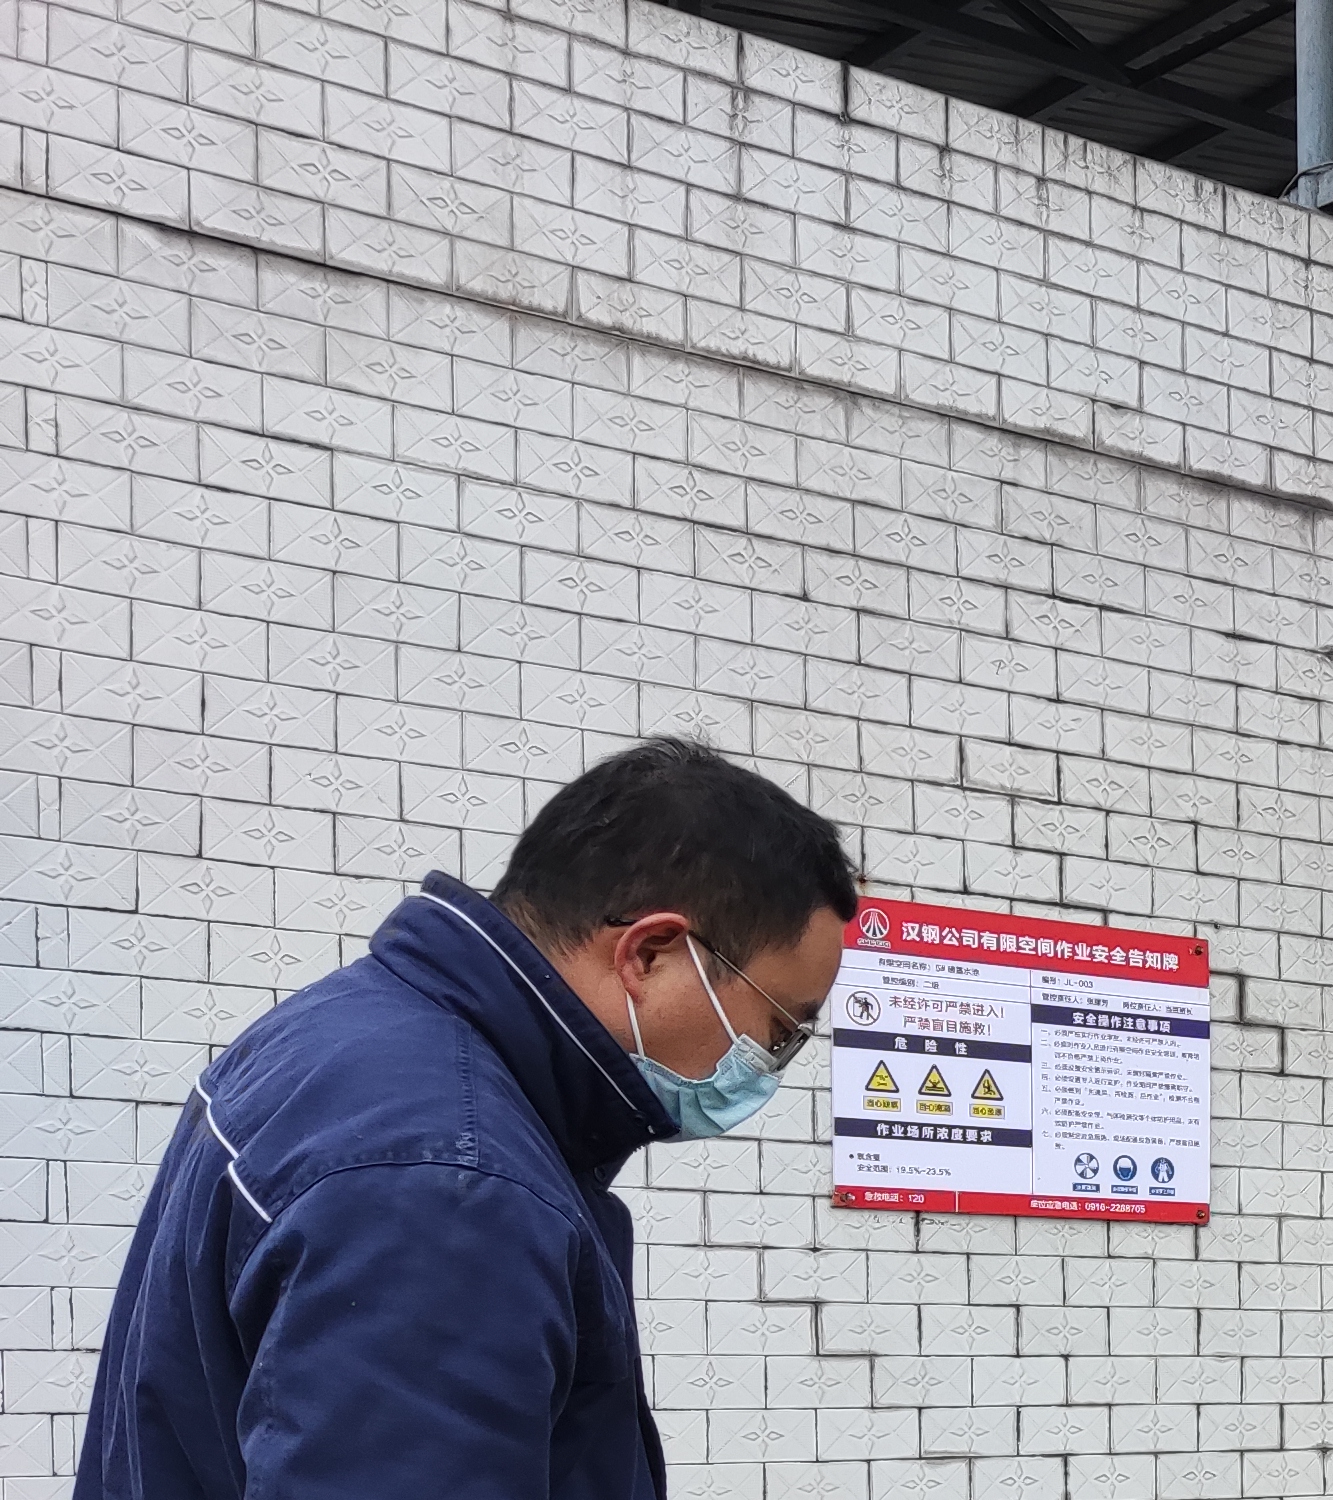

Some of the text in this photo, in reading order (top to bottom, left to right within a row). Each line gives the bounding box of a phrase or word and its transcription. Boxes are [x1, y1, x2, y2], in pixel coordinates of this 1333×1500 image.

[901, 921, 1179, 972] 汉钢公司有限空间作业安全告知牌
[1072, 1011, 1171, 1033] 安全操作注意事项
[894, 1036, 968, 1055] 危险性
[876, 1123, 993, 1142] 作业场所浓度要求
